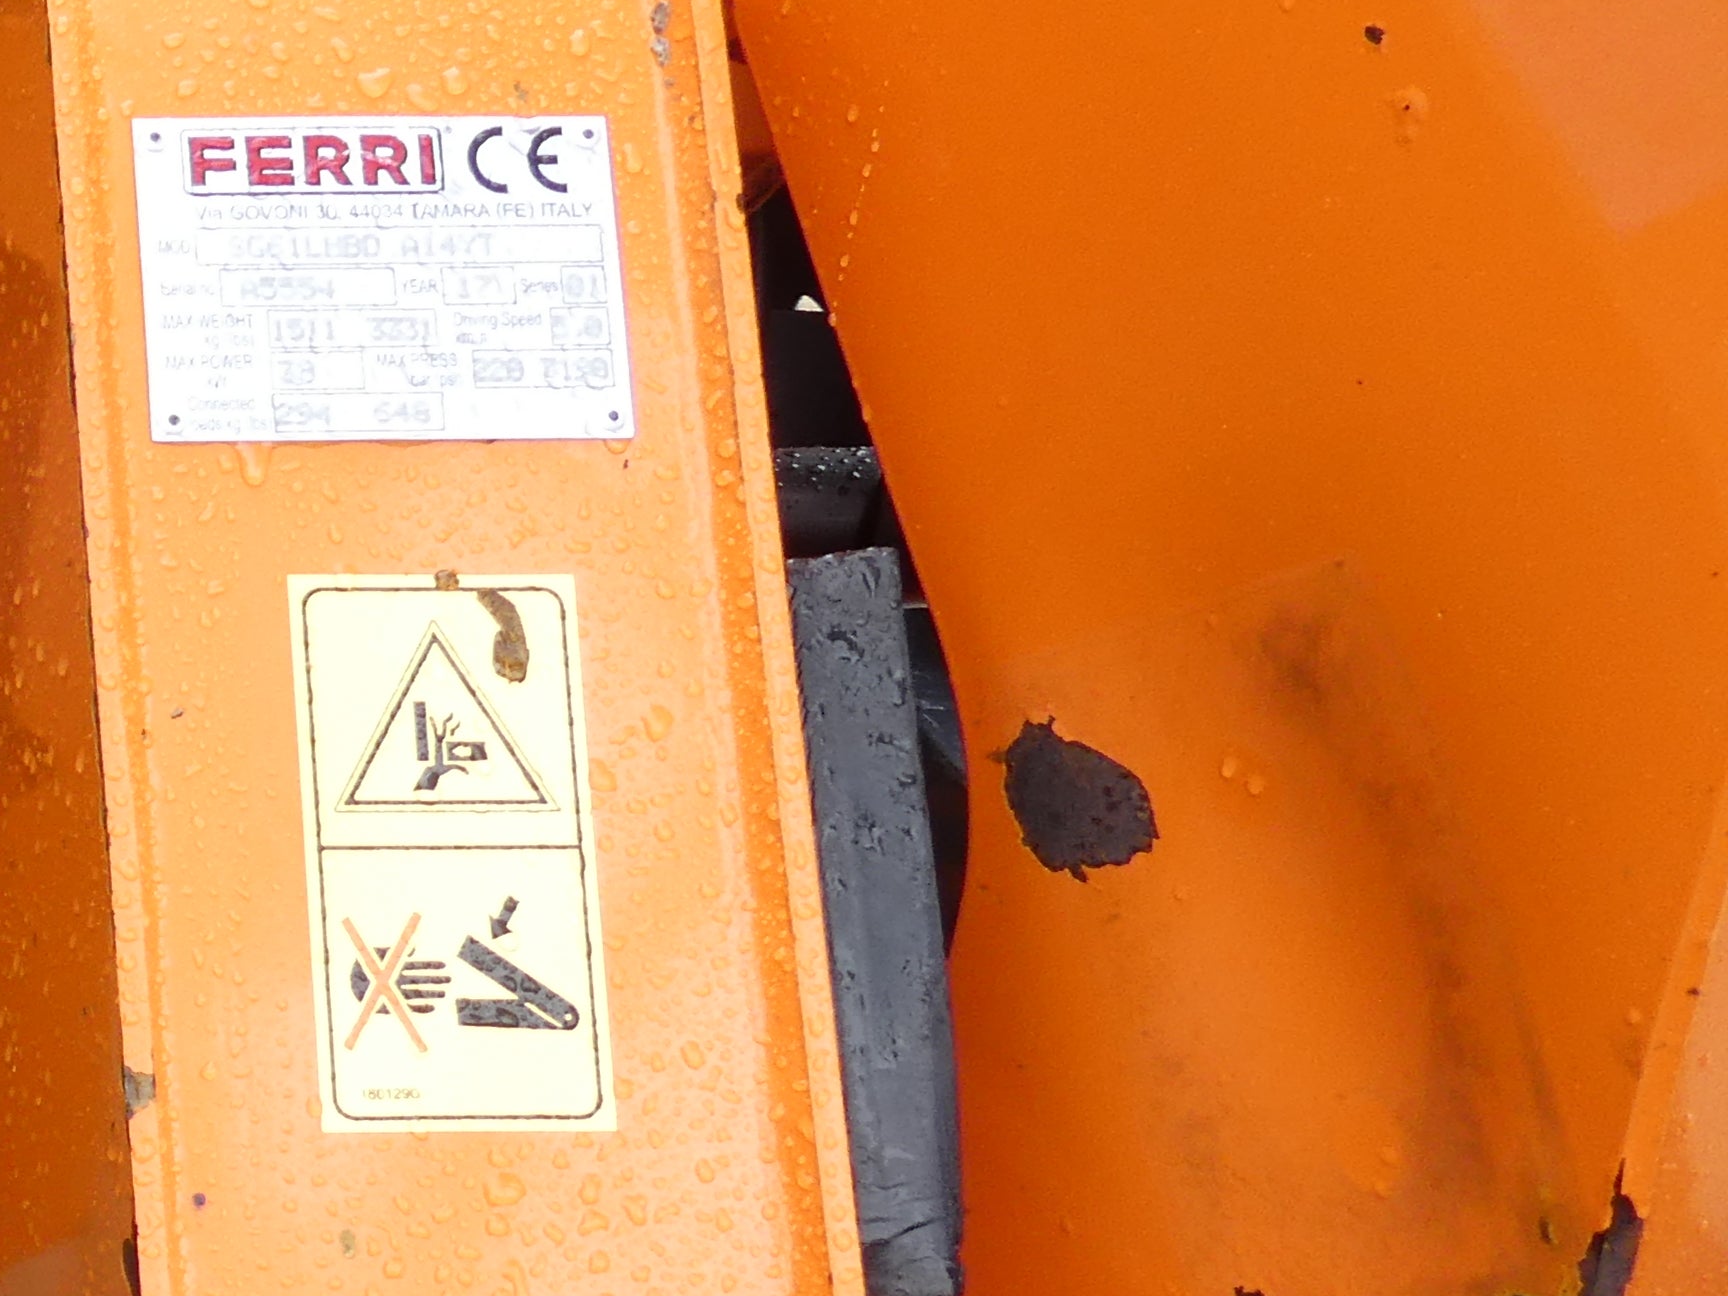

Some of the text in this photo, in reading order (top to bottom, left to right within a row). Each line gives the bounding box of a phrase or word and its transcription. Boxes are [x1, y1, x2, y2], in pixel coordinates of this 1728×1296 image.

[188, 126, 569, 194] FERRI CE
[231, 204, 309, 220] GOVONI
[412, 202, 491, 219] TAMARA
[496, 202, 535, 219] (FE)
[541, 202, 593, 218] ITALY
[402, 278, 439, 294] YEAR
[162, 313, 193, 330] MAX
[199, 313, 254, 329] WEIGHT
[501, 311, 543, 329] Speed
